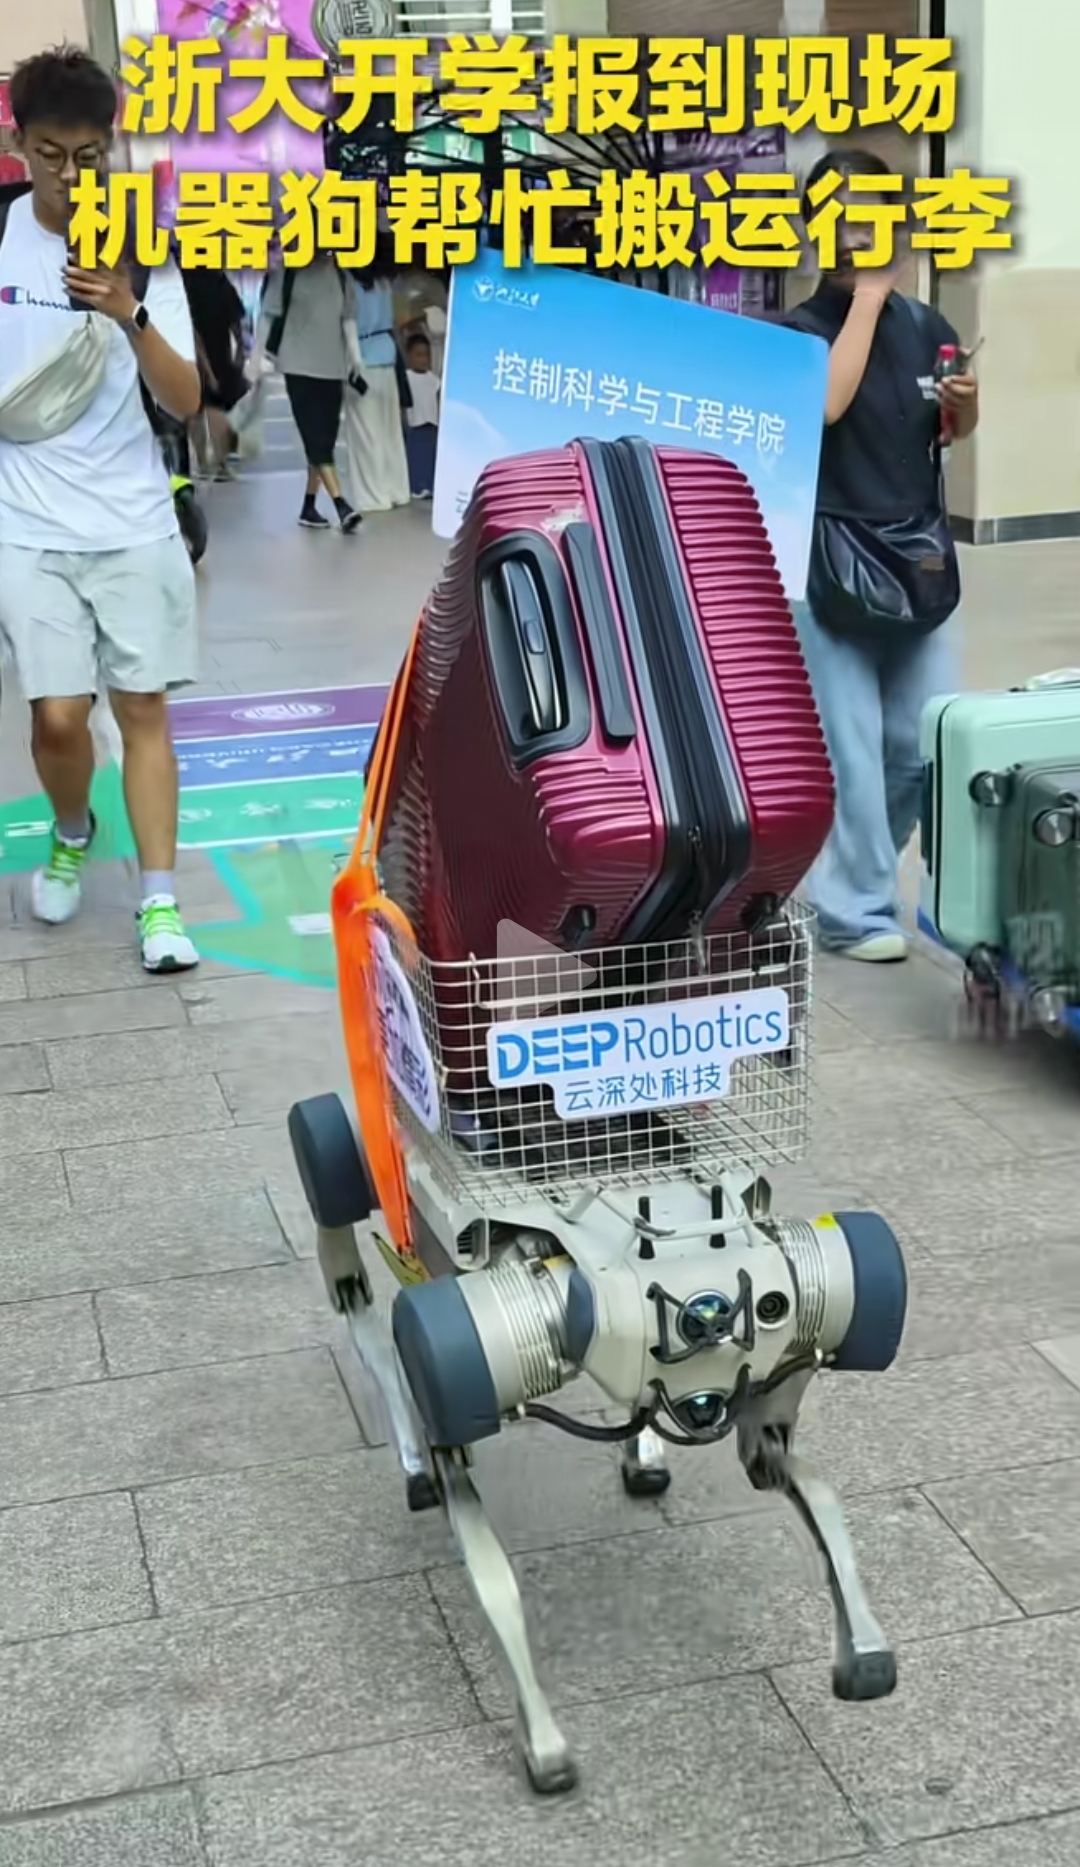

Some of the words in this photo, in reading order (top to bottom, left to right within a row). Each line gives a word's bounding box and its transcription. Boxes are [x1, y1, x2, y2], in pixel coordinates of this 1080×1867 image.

[493, 348, 786, 455] 控制科学与工程学院
[564, 1062, 722, 1112] 云深处科技
